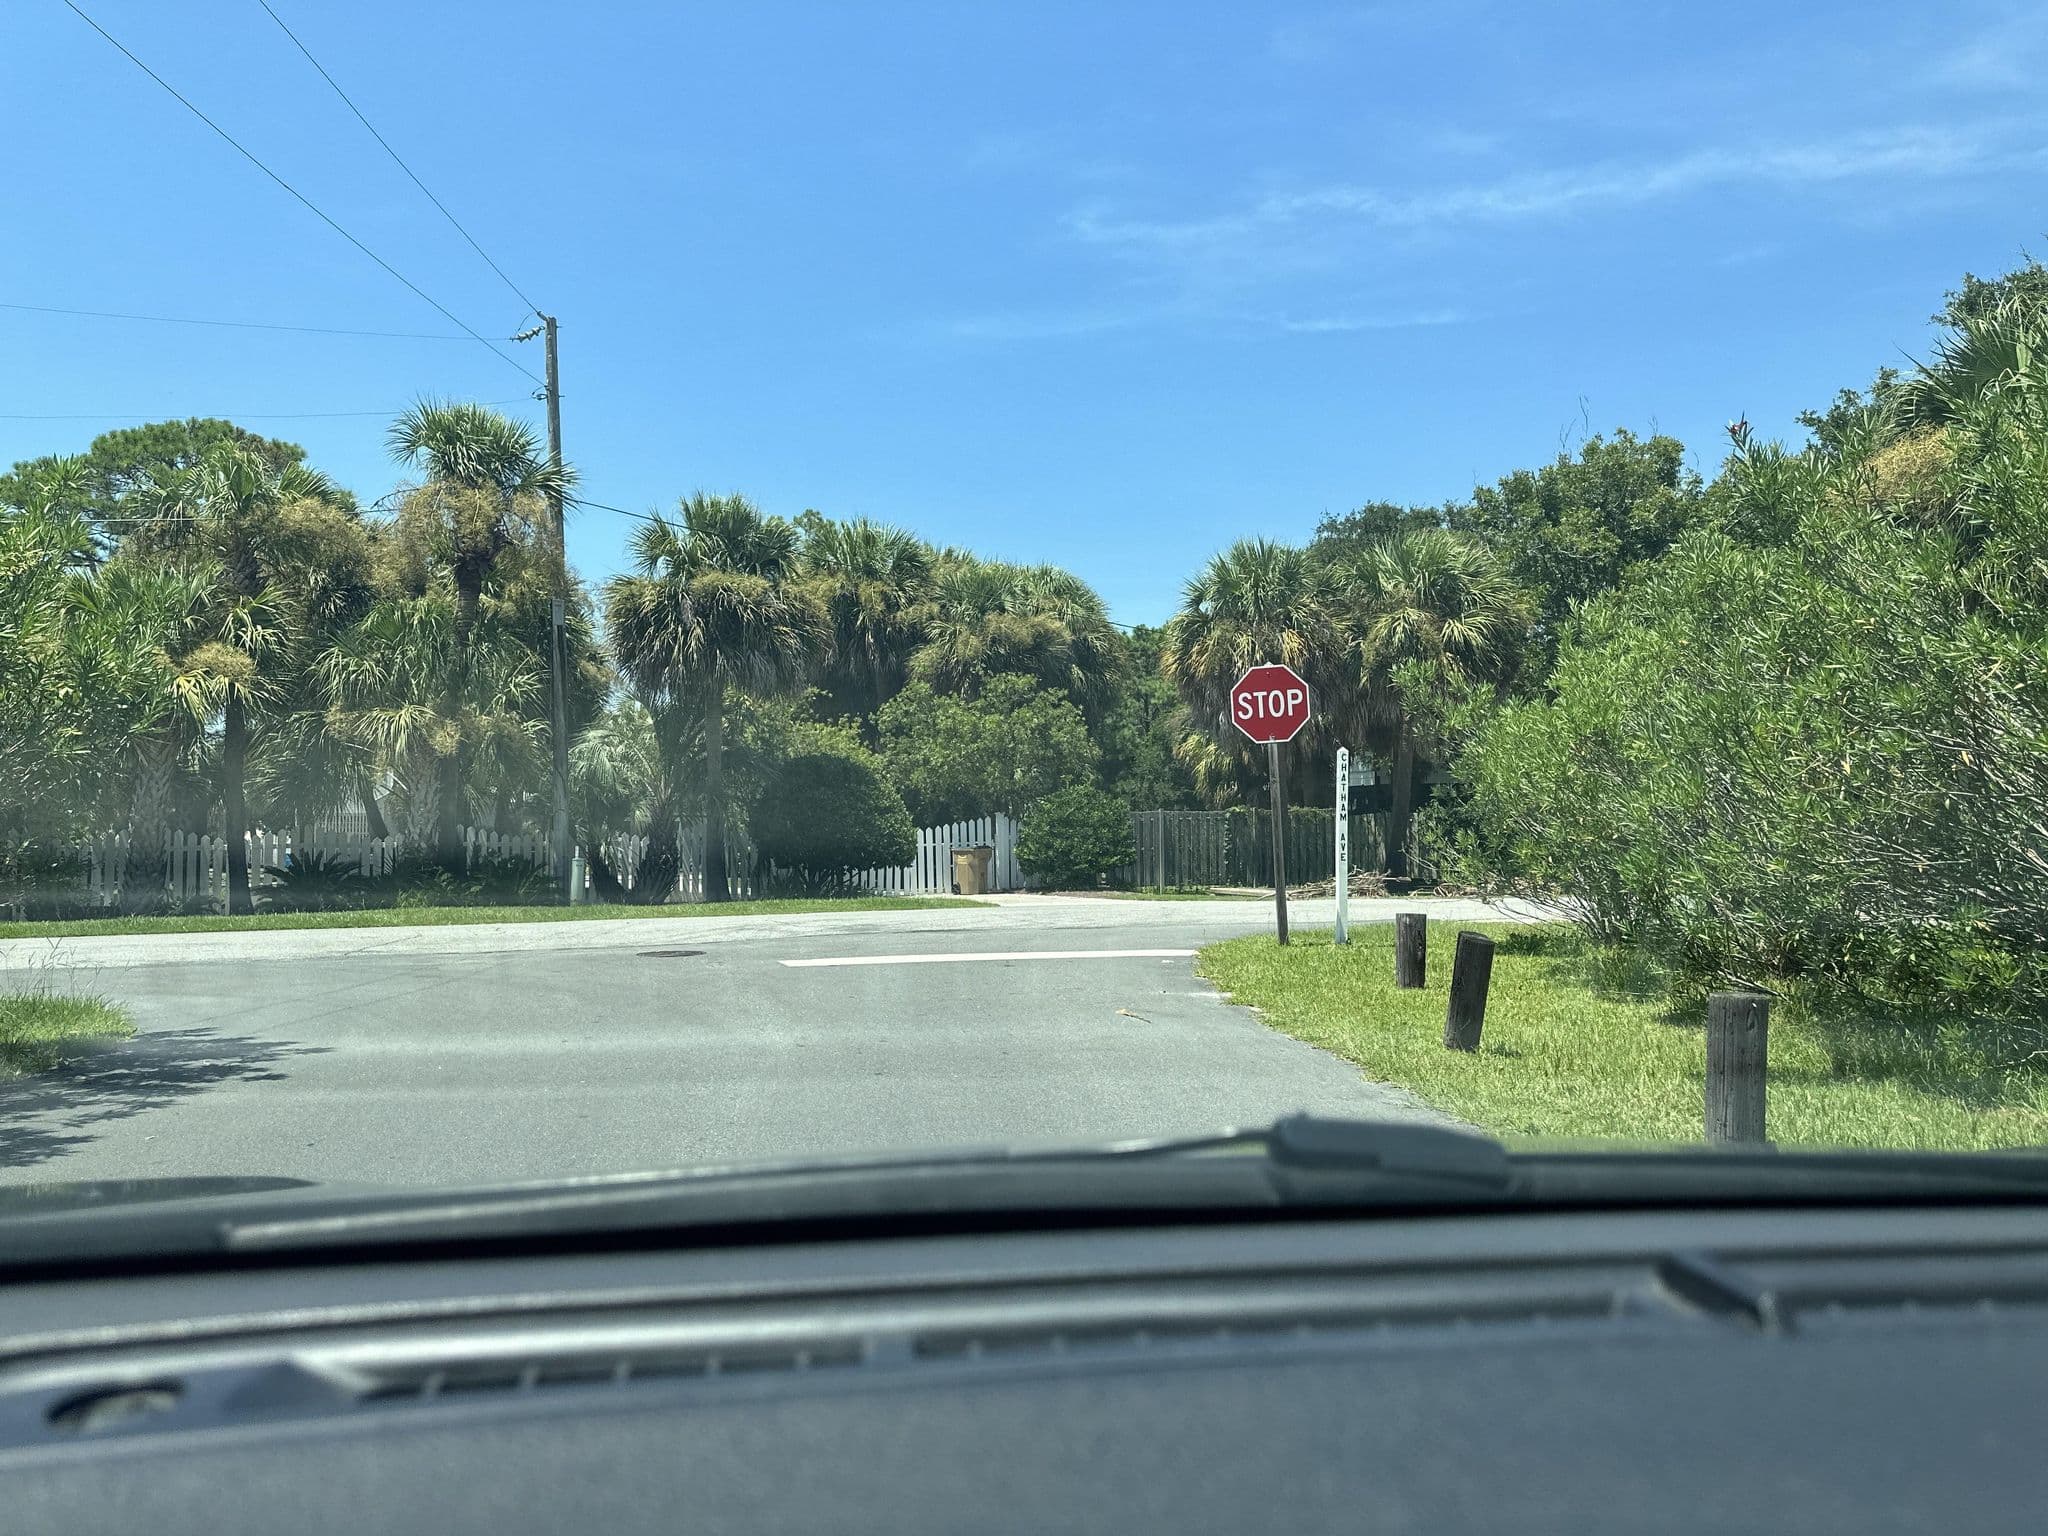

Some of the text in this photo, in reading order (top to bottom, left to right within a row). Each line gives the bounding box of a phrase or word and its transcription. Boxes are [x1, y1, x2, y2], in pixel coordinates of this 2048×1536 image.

[1237, 689, 1303, 720] STOP
[1339, 753, 1347, 862] CHATHAM AVE
